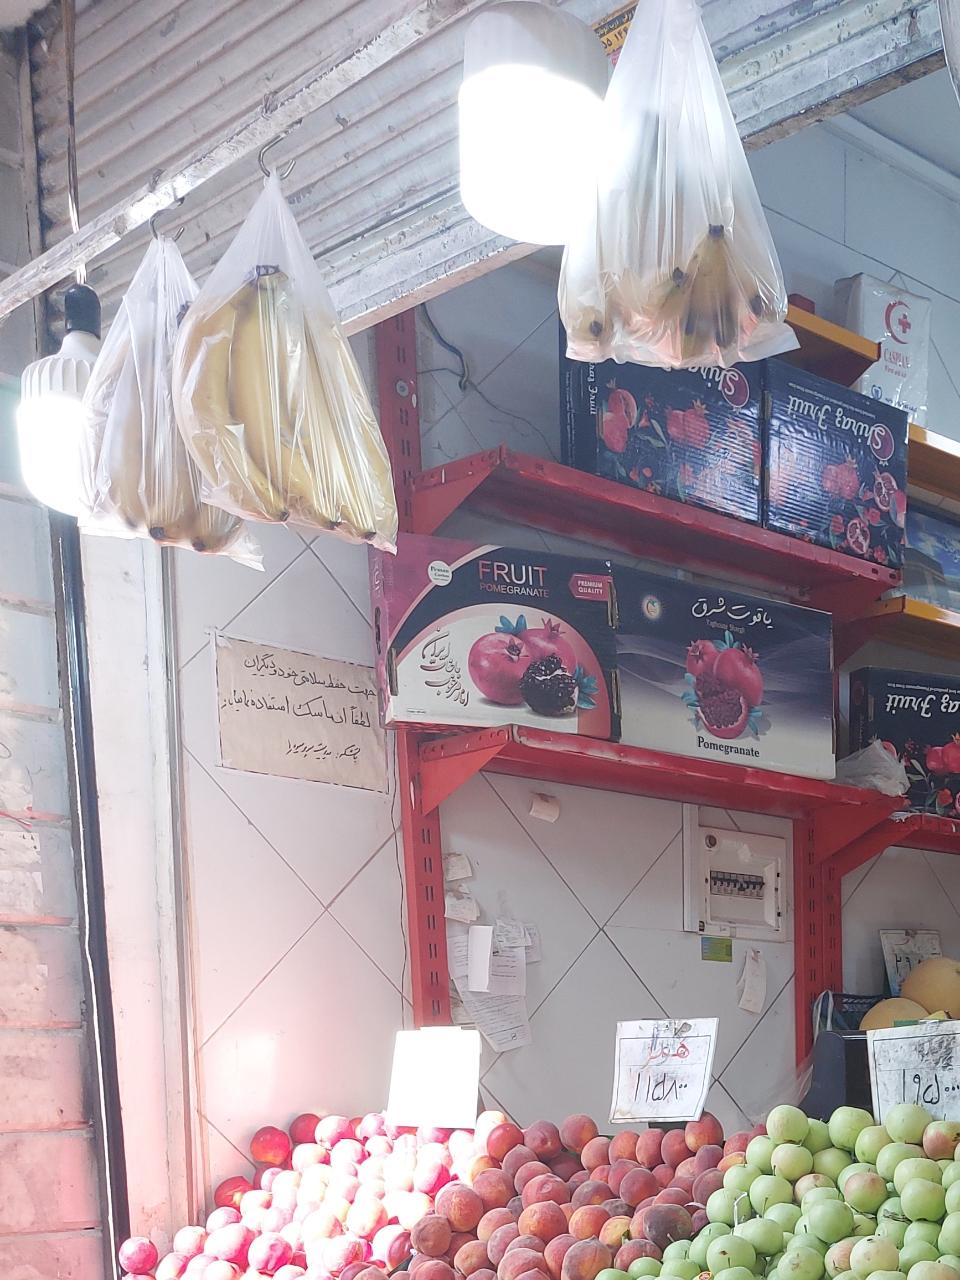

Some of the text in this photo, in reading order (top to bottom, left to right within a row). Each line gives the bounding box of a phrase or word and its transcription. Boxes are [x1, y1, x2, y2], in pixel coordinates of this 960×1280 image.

[787, 395, 832, 430] Fruit
[835, 407, 886, 450] Shiraz
[479, 560, 548, 587] FRUIT
[577, 580, 603, 588] PREMIUM
[479, 583, 550, 598] POMEGRANATE
[691, 597, 774, 629] یاقوت شرق
[886, 693, 937, 718] Fruit
[697, 735, 761, 759] Pomegranate
